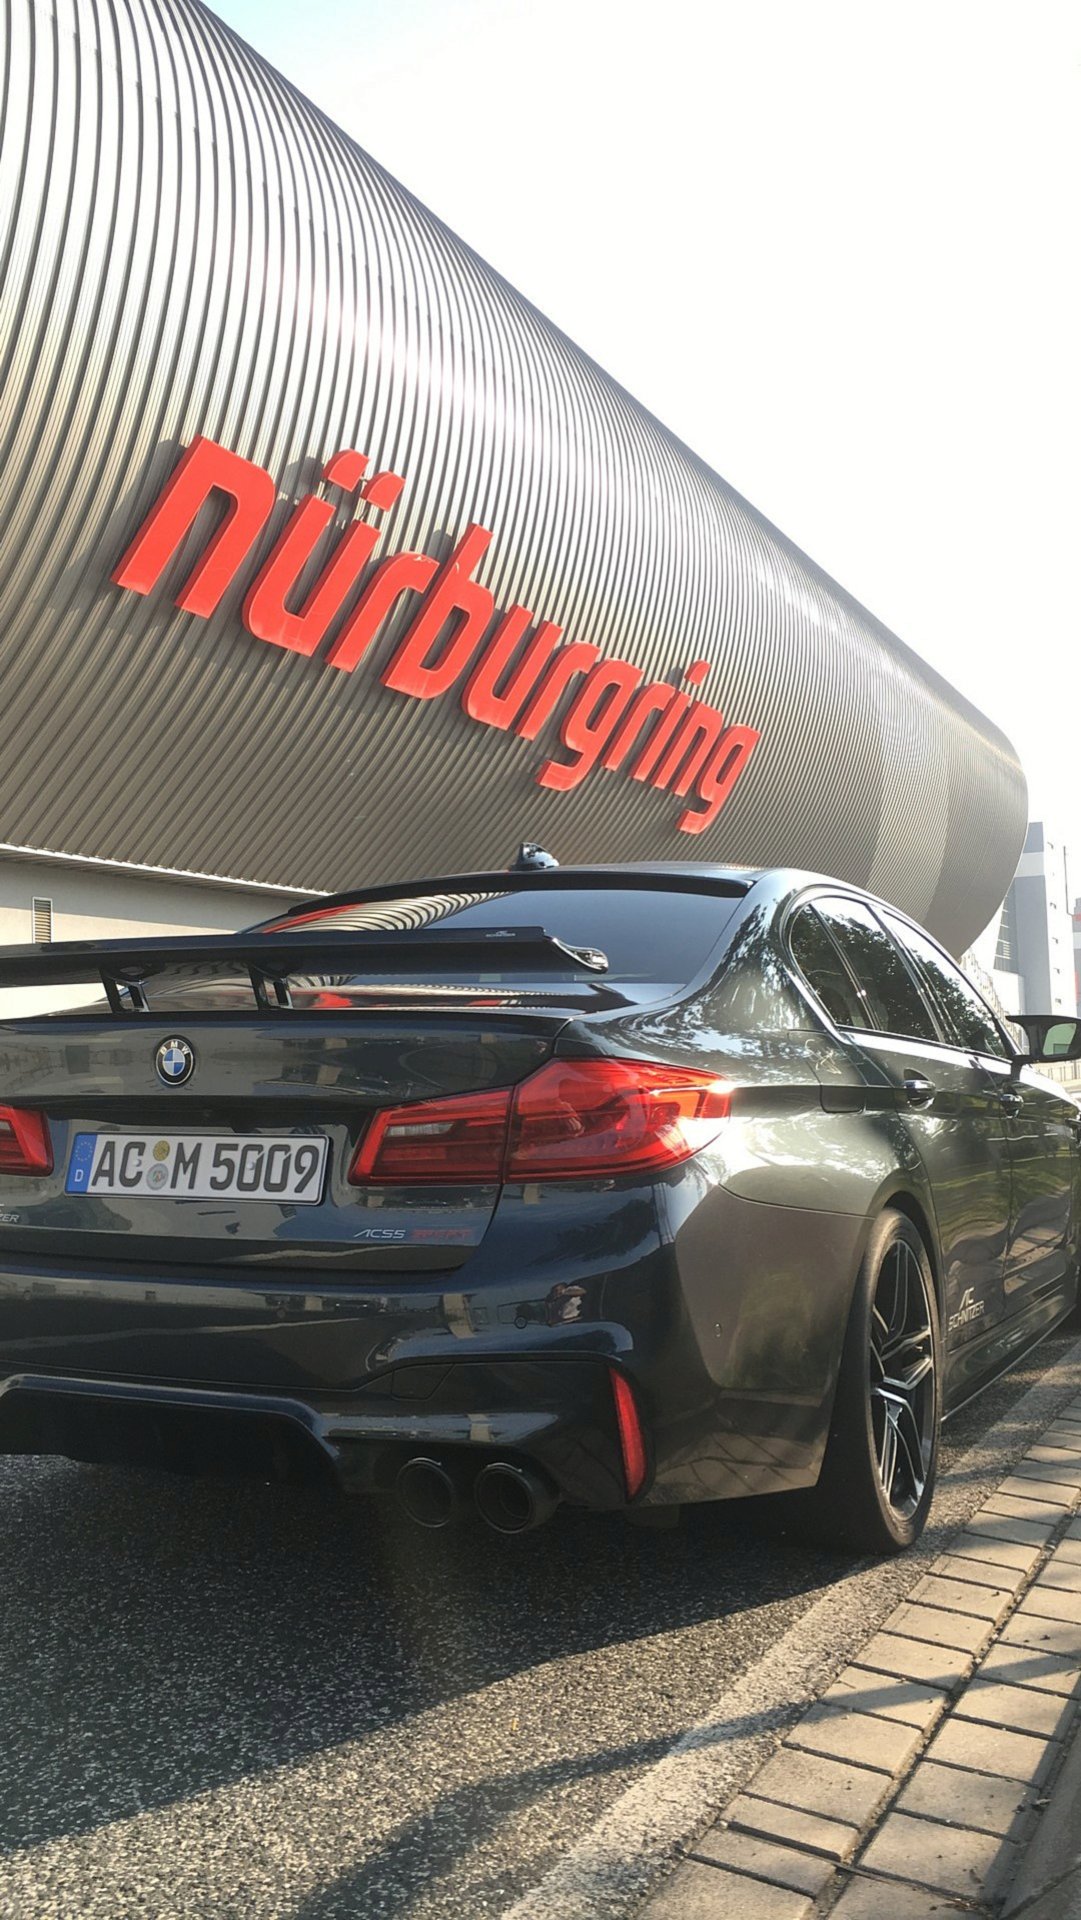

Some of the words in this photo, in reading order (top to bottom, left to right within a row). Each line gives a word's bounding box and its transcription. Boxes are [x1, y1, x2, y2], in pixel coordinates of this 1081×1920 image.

[111, 434, 761, 834] nürburgring
[74, 1169, 84, 1182] D
[92, 1141, 146, 1187] AC
[170, 1142, 202, 1190] M
[210, 1143, 320, 1193] 5009
